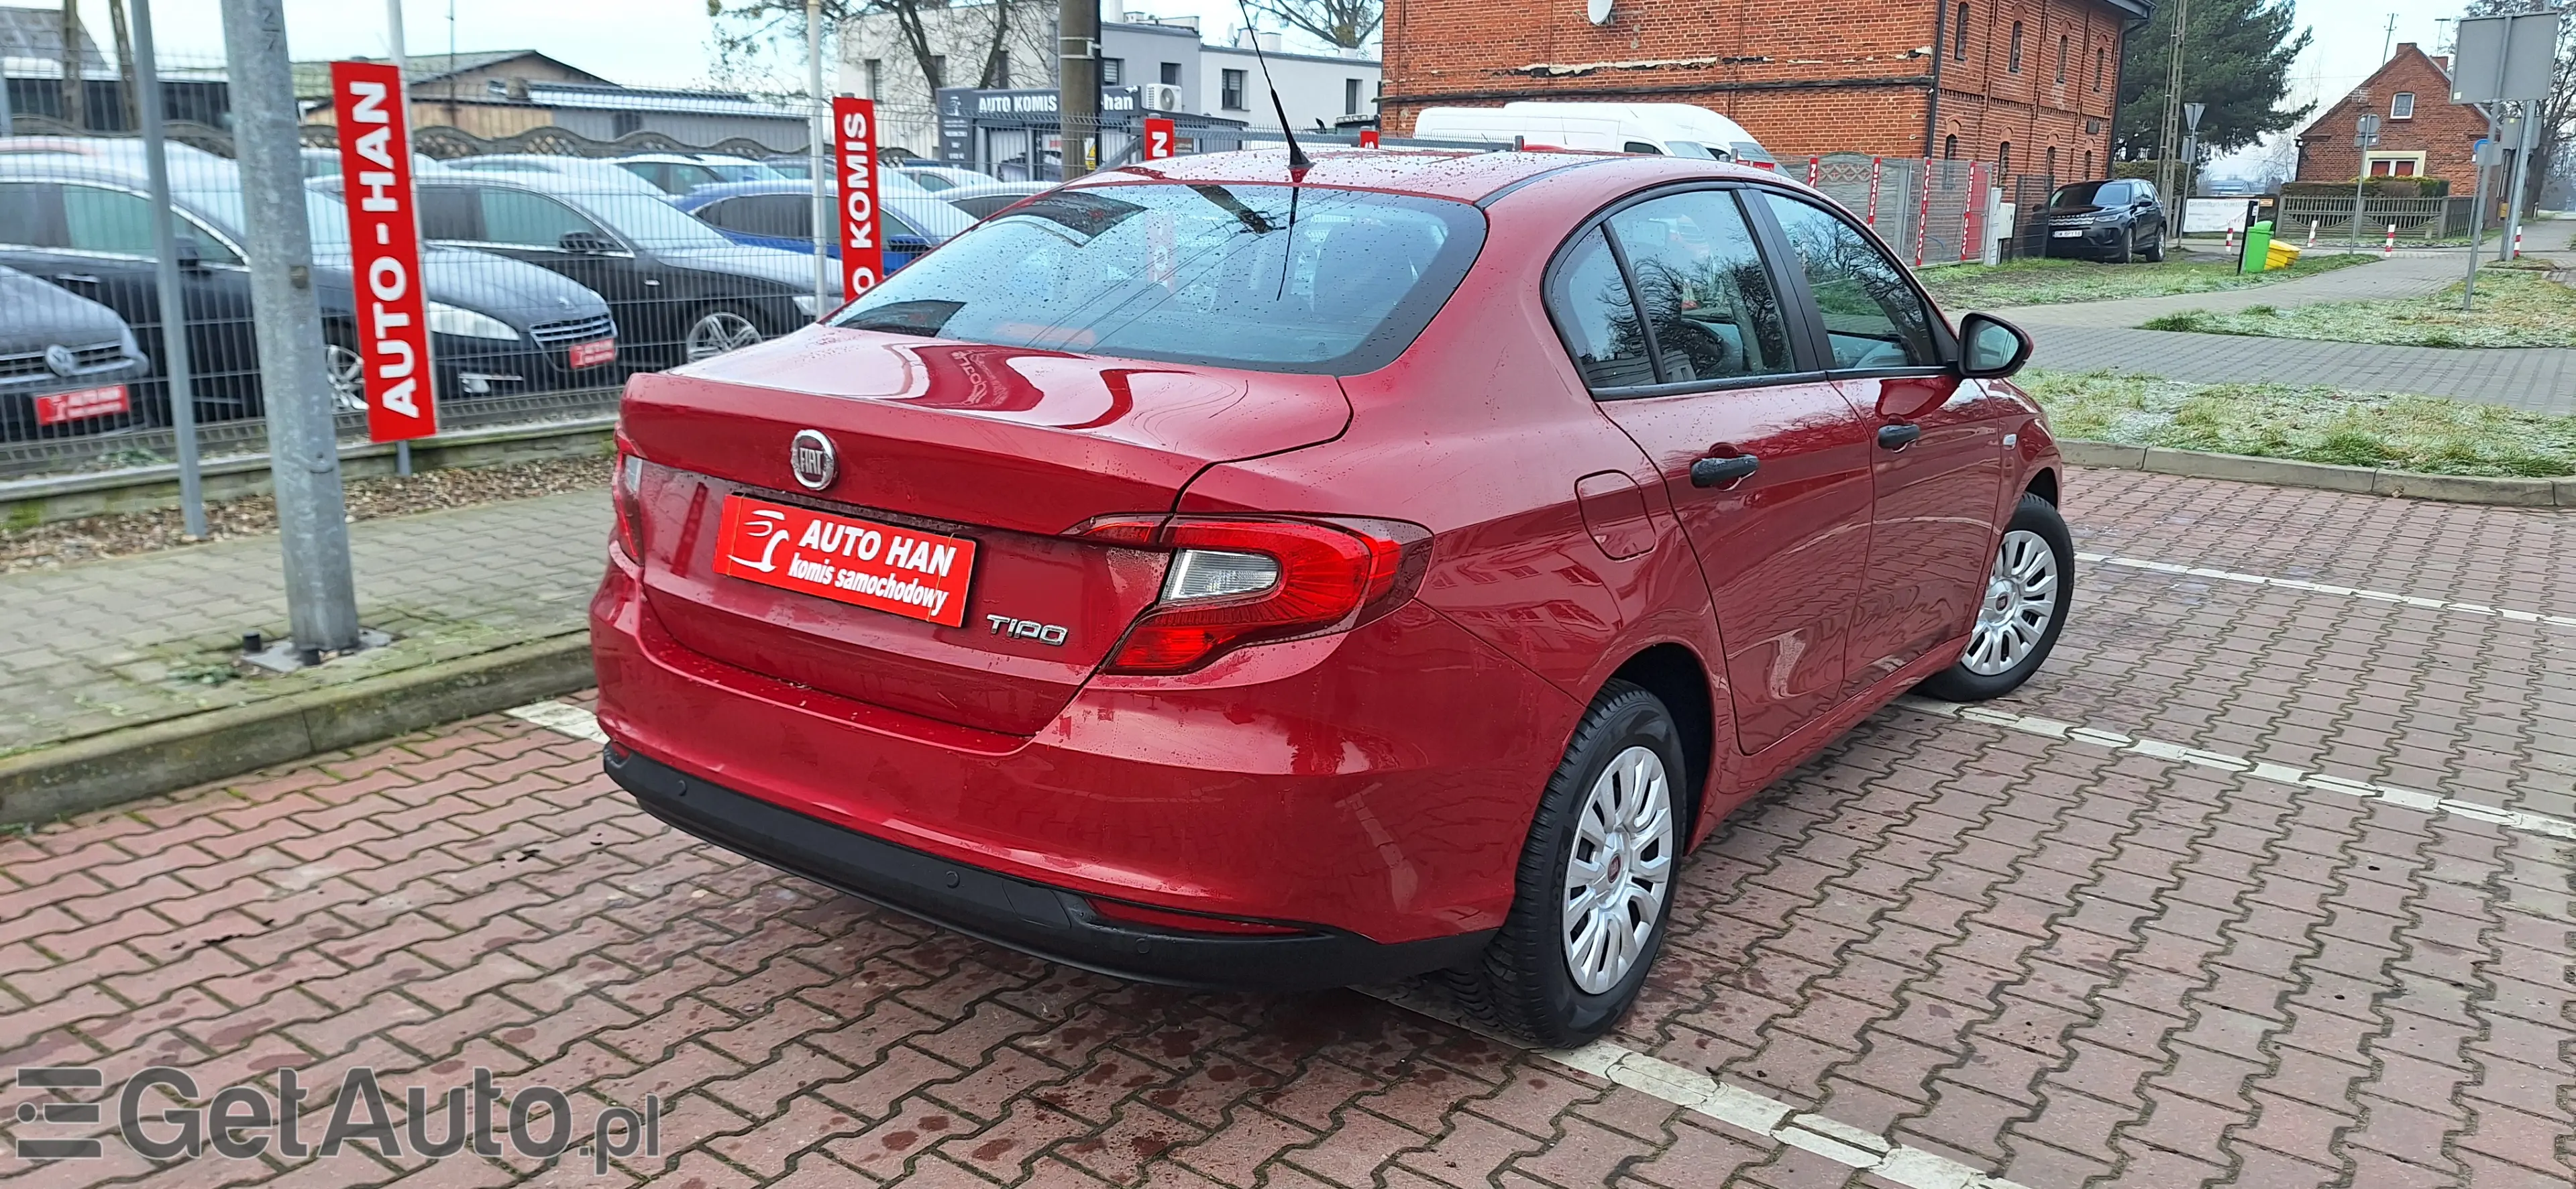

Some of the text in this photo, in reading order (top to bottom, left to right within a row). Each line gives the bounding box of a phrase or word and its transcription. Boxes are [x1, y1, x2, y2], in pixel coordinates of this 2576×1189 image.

[978, 97, 1011, 113] AUTO
[1014, 95, 1057, 113] KOMIS
[350, 81, 398, 212] HAN
[843, 113, 873, 248] KOMIS
[369, 256, 420, 419] AUTO
[800, 447, 823, 475] FIAT
[798, 520, 957, 578] AUTO HAN
[788, 552, 949, 616] komis samochodowy
[986, 614, 1069, 646] TIPO
